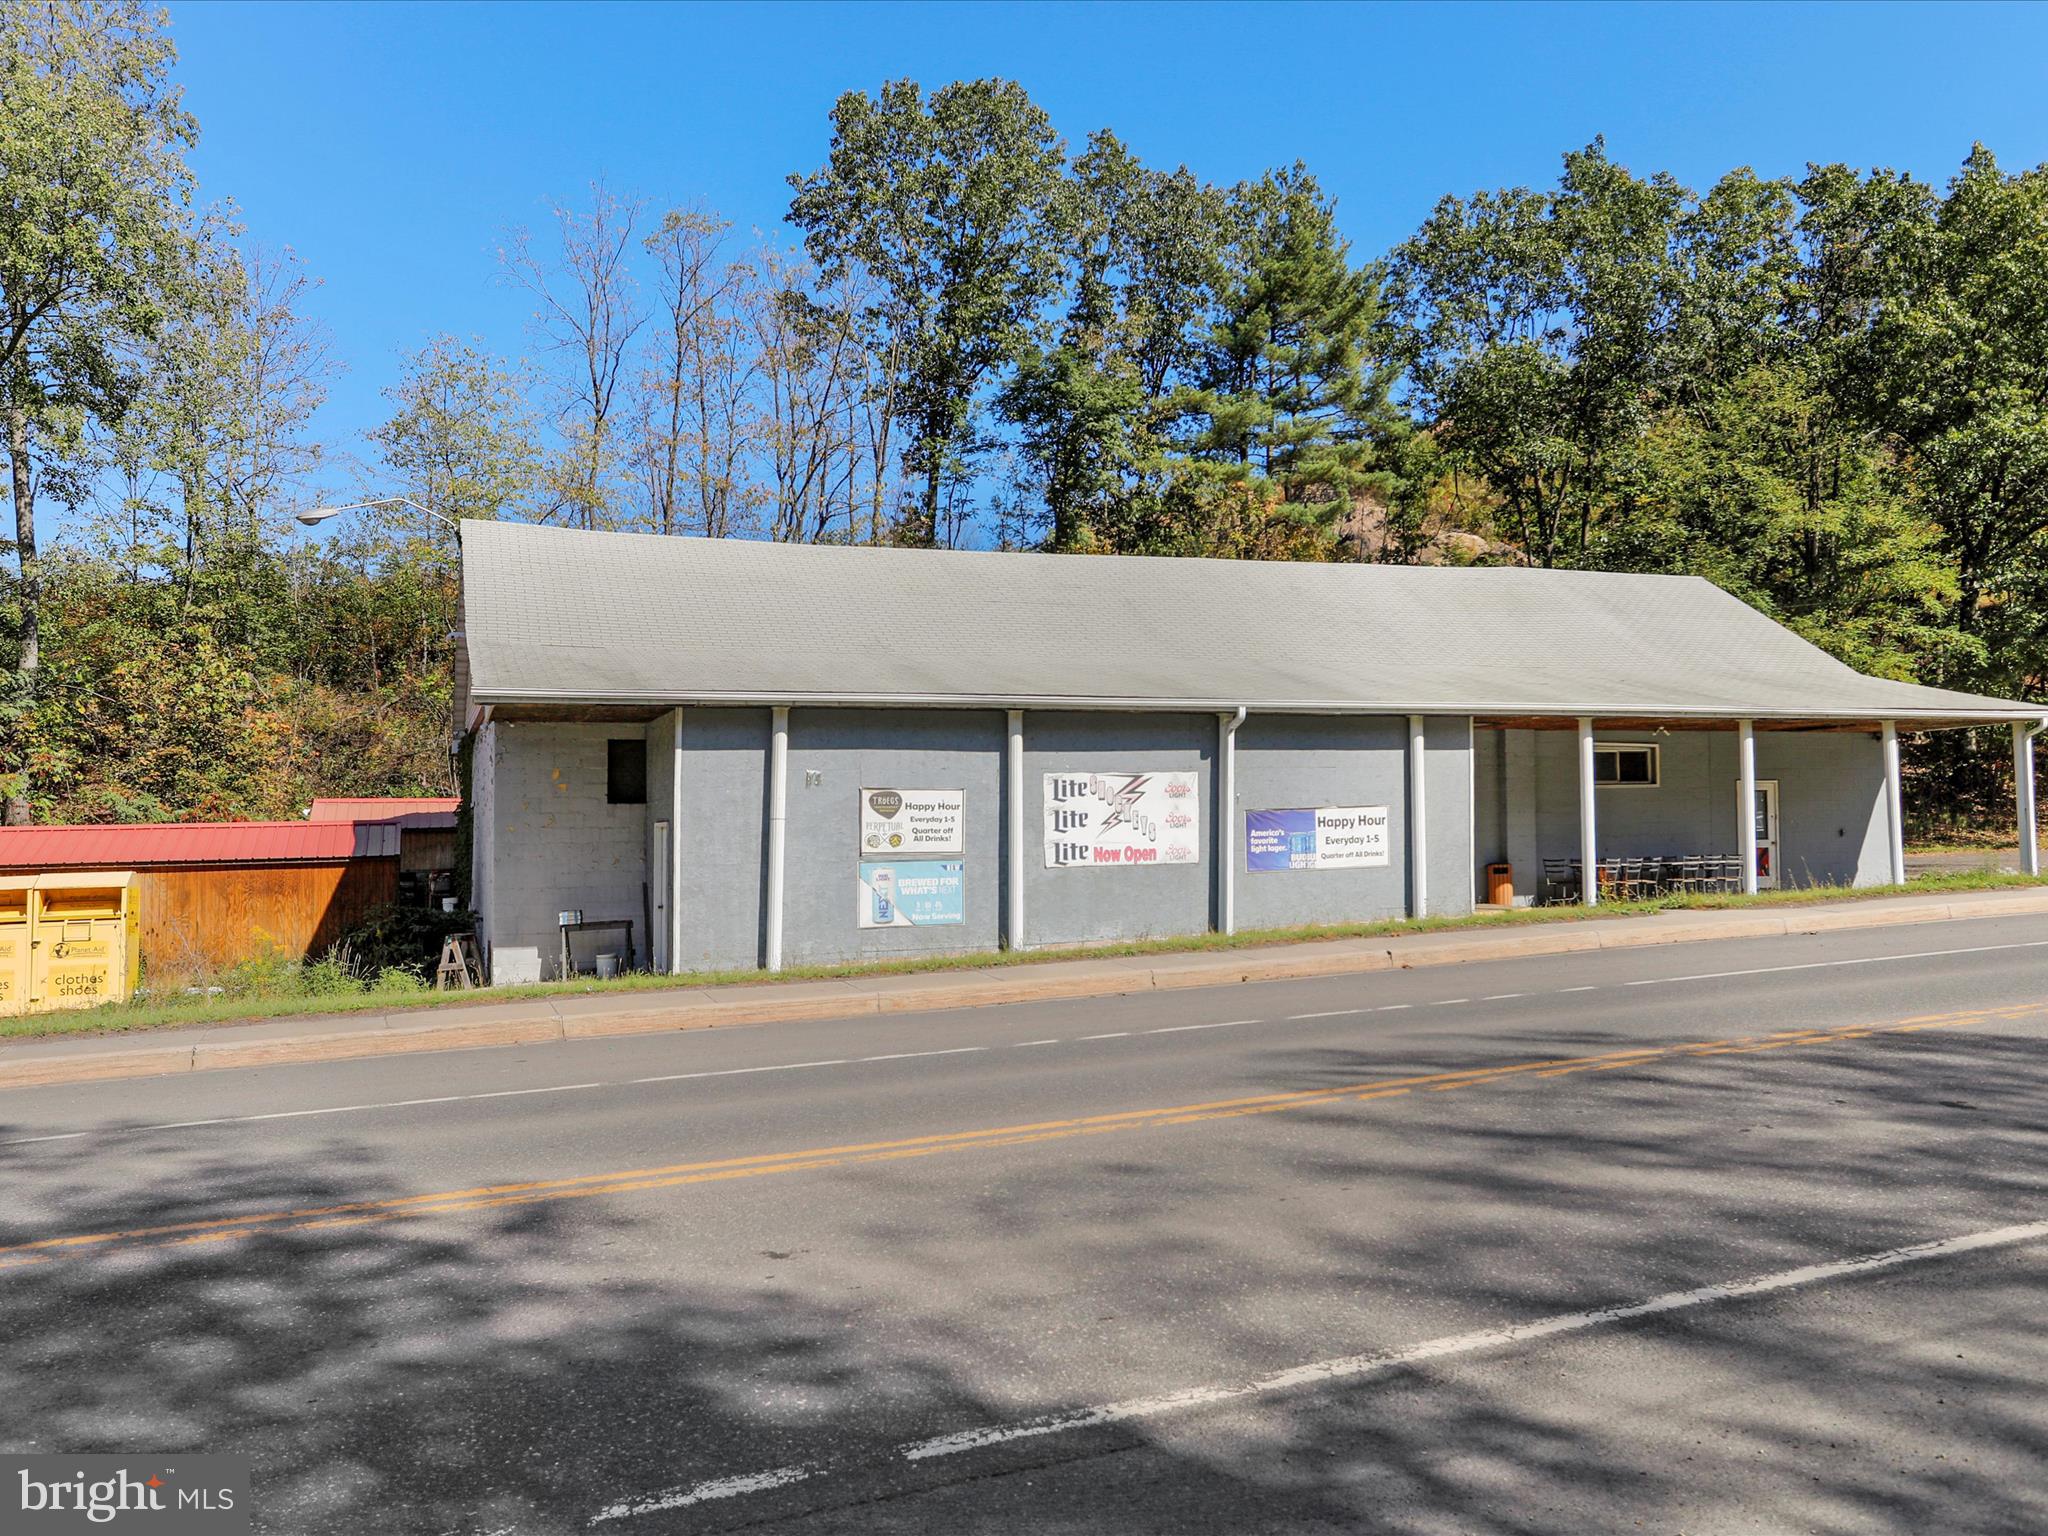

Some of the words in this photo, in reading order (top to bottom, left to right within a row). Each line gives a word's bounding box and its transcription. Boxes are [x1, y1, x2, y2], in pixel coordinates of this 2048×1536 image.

[1052, 778, 1088, 803] Lite
[1164, 782, 1191, 793] Coors
[905, 802, 936, 812] Happy
[937, 801, 961, 811] Hour
[910, 815, 943, 824] Everyday
[1053, 809, 1089, 834] Lite
[1165, 812, 1192, 823] Coors
[1317, 815, 1356, 830] Happy
[1358, 814, 1386, 826] Hour
[865, 821, 904, 833] PERPETUAL
[911, 827, 941, 836] Quarter
[1250, 829, 1285, 837] America's
[1250, 837, 1278, 845] favorite
[1325, 836, 1364, 846] Everyday
[1366, 834, 1380, 843] 1-5
[1053, 842, 1089, 866] Lite
[1250, 845, 1267, 854] light
[1267, 844, 1288, 853] lager.
[1093, 846, 1121, 862] Now
[1124, 845, 1157, 865] Open
[1320, 852, 1345, 860] Quarter
[1345, 851, 1354, 859] off
[1363, 850, 1385, 858] Drinks!
[898, 878, 939, 887] BREWED
[940, 877, 960, 886] FOR
[900, 886, 938, 895] WHAT'S
[931, 913, 961, 921] Serving
[55, 973, 104, 985] clothes
[60, 985, 98, 996] shoes
